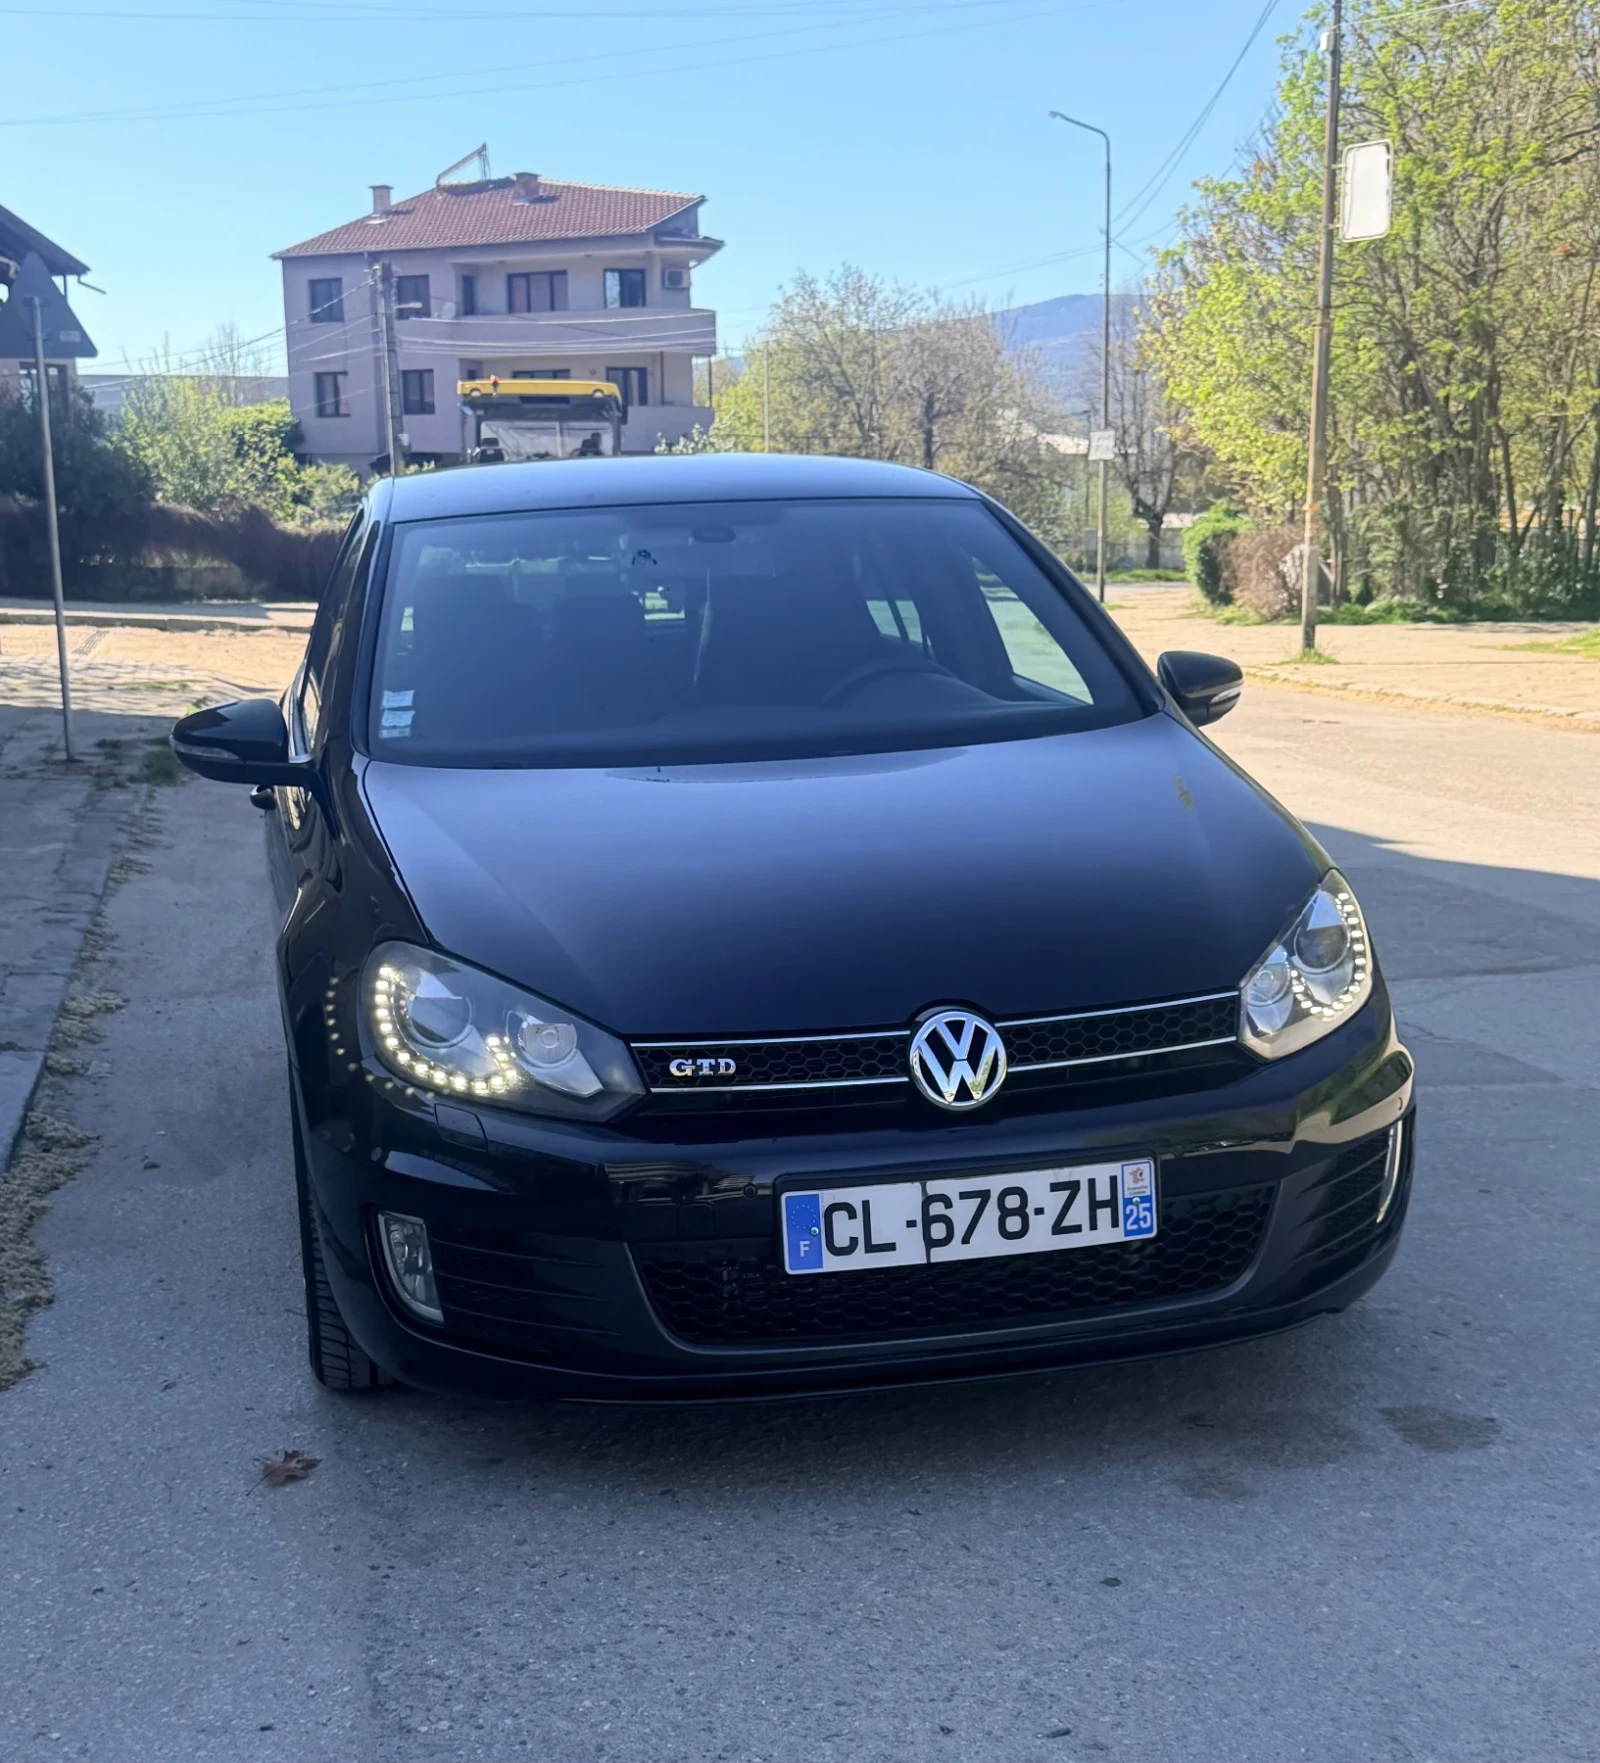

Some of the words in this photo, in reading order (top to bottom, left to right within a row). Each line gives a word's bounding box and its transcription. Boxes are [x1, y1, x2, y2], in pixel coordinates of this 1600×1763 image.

[669, 1058, 736, 1076] GTD
[1125, 1202, 1151, 1231] 25
[799, 1240, 810, 1257] F
